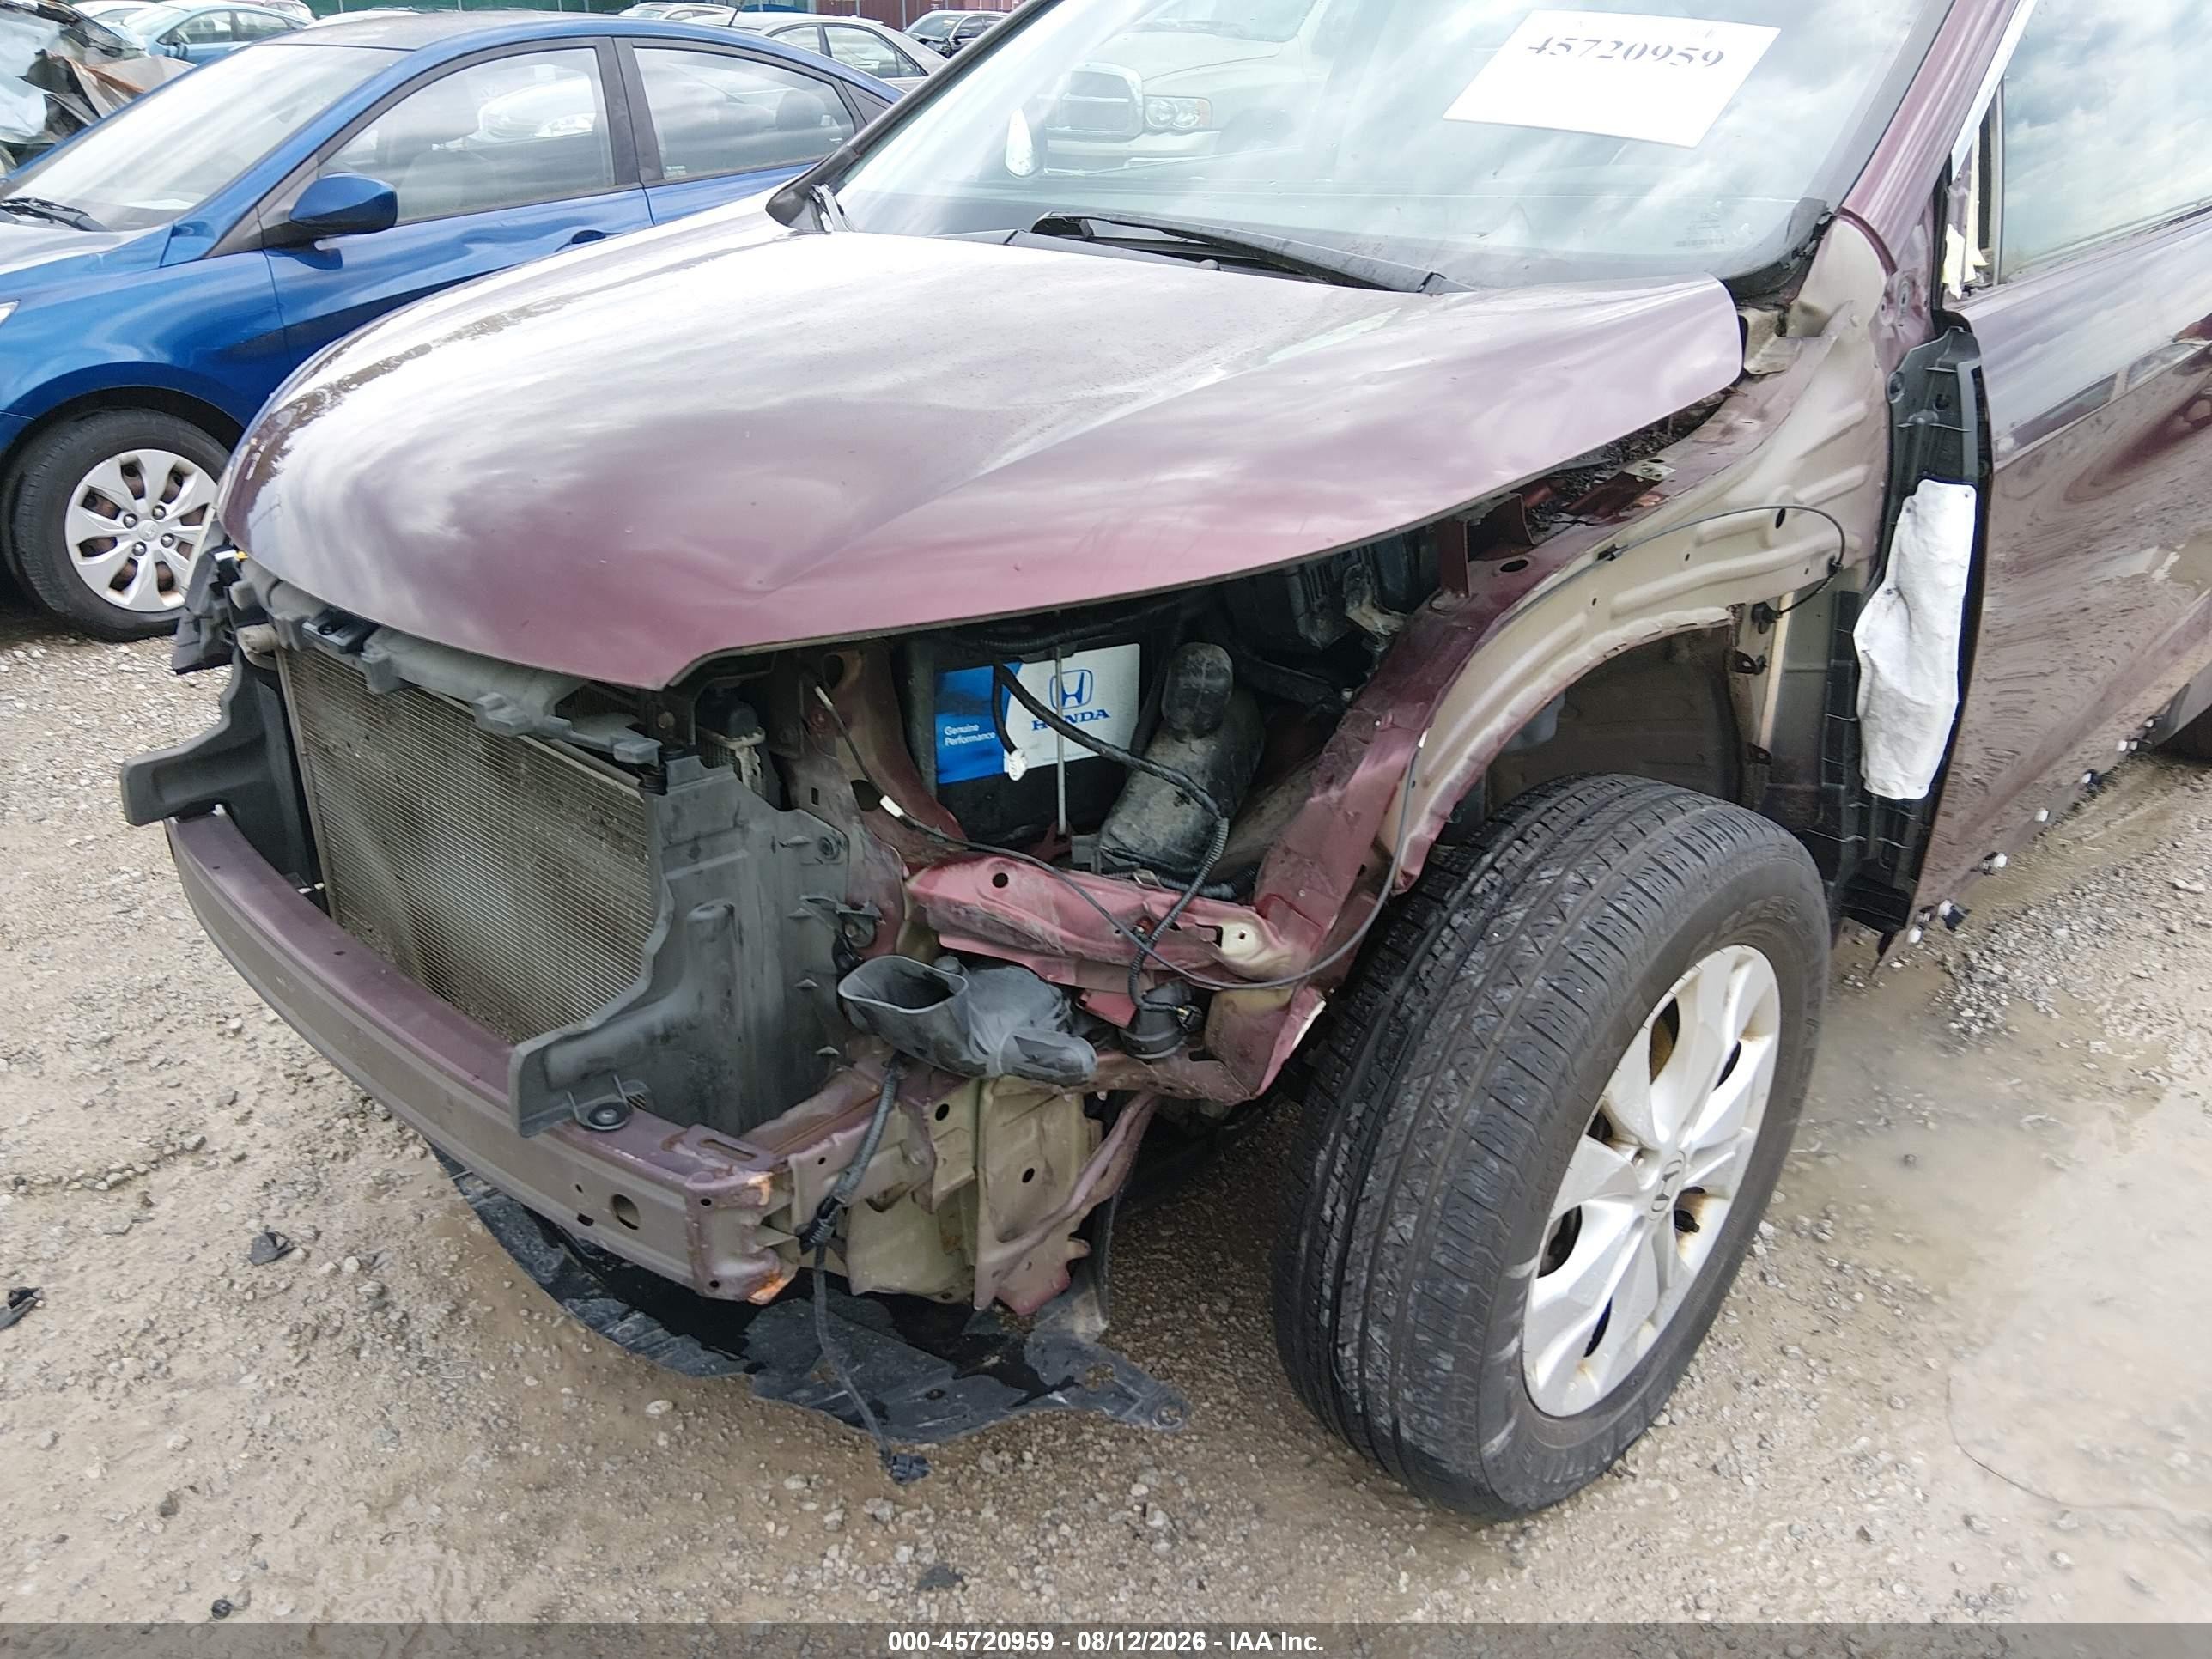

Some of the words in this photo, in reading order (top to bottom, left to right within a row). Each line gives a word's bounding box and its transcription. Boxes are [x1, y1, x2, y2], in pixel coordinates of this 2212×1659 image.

[1528, 37, 1723, 66] 45720959
[1031, 708, 1110, 730] HNDA
[945, 724, 979, 736] Genuine
[945, 732, 995, 746] Performance
